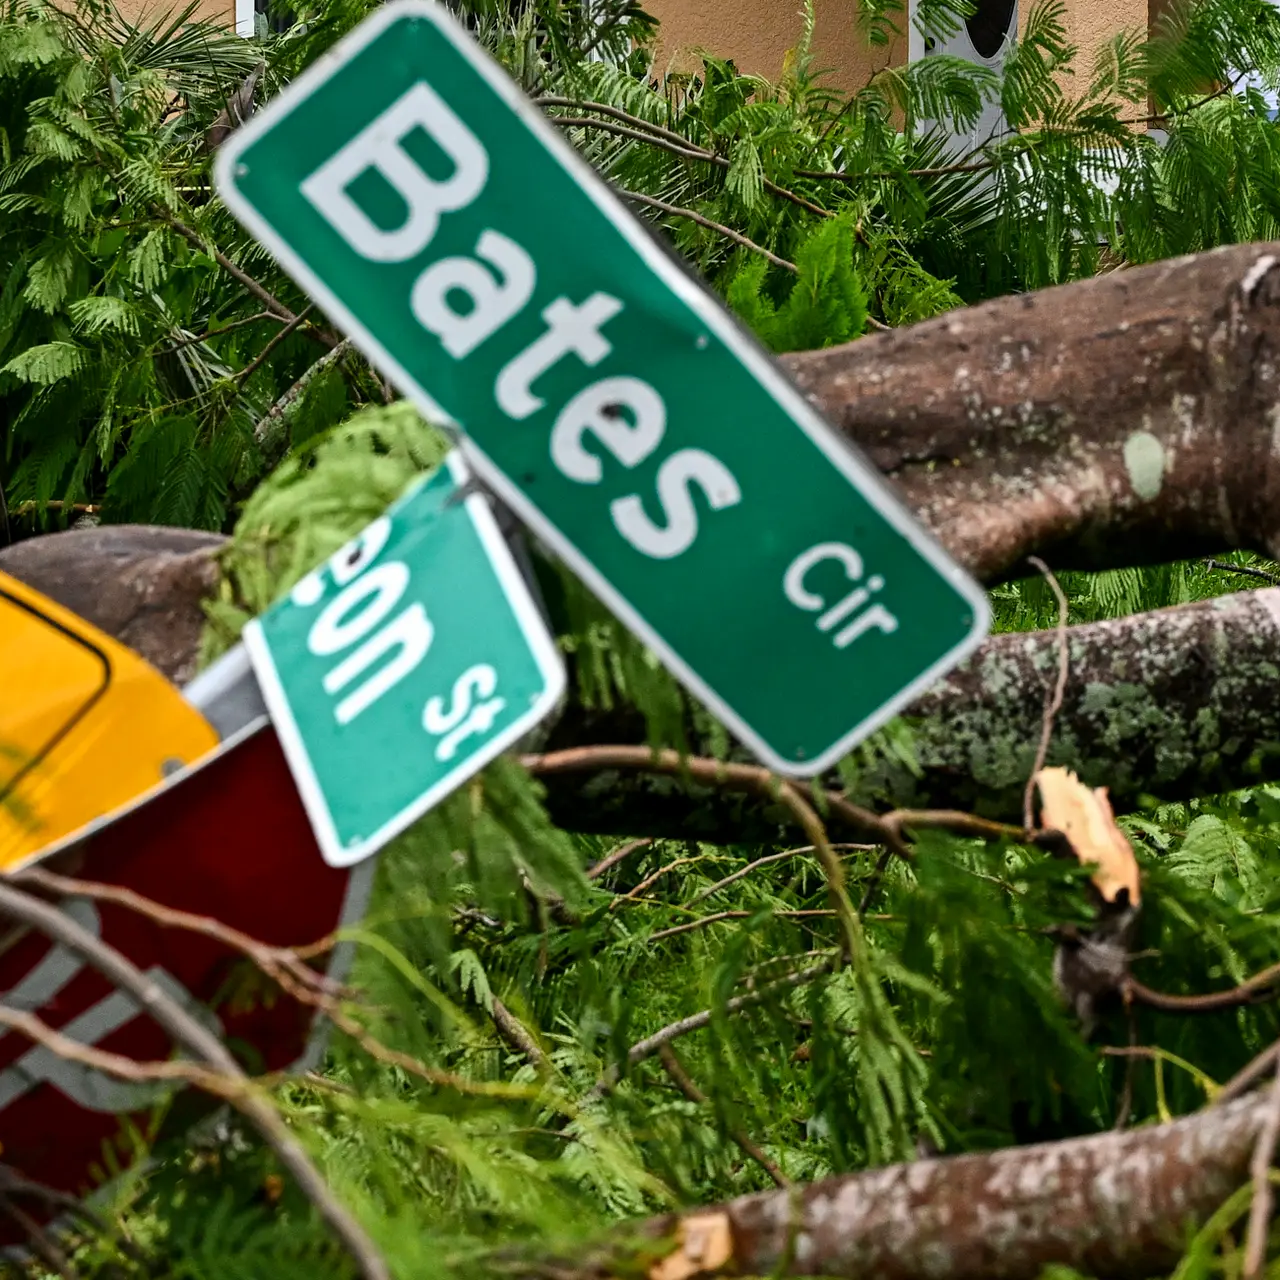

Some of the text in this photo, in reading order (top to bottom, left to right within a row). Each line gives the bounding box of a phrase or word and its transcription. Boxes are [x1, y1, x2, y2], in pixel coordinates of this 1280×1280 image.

[300, 81, 899, 650] Bates Cir
[422, 663, 506, 762] St
